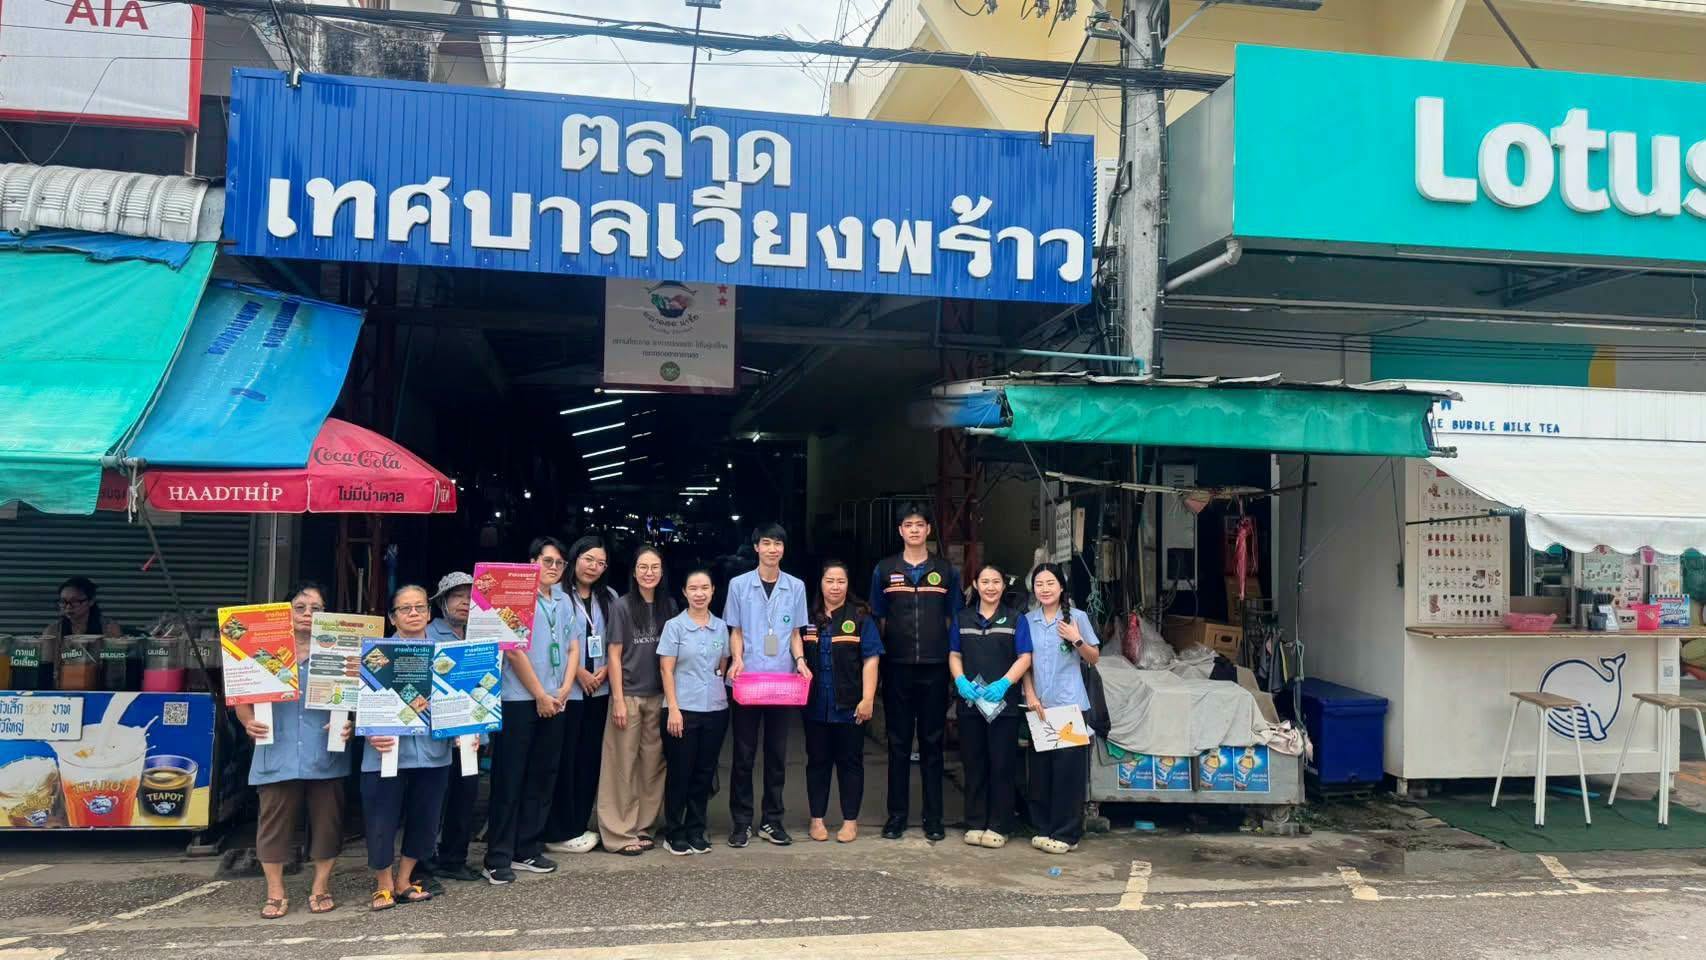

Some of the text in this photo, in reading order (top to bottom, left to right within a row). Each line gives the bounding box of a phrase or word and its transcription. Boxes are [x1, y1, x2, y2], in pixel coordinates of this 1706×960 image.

[65, 0, 148, 30] AIA
[561, 113, 791, 187] ตลาด
[267, 176, 1084, 282] เทศบาลเวียงพร้าว
[1452, 420, 1495, 431] BUBBLE
[1503, 422, 1531, 432] MILK
[1540, 423, 1560, 433] TEA
[314, 447, 401, 469] Coca-Cola
[338, 482, 404, 502] ไม่มีน้ำตาล
[52, 703, 71, 716] บาท
[51, 722, 70, 734] บาท
[74, 780, 131, 794] TEAPOT
[146, 793, 185, 802] TEAPOT
